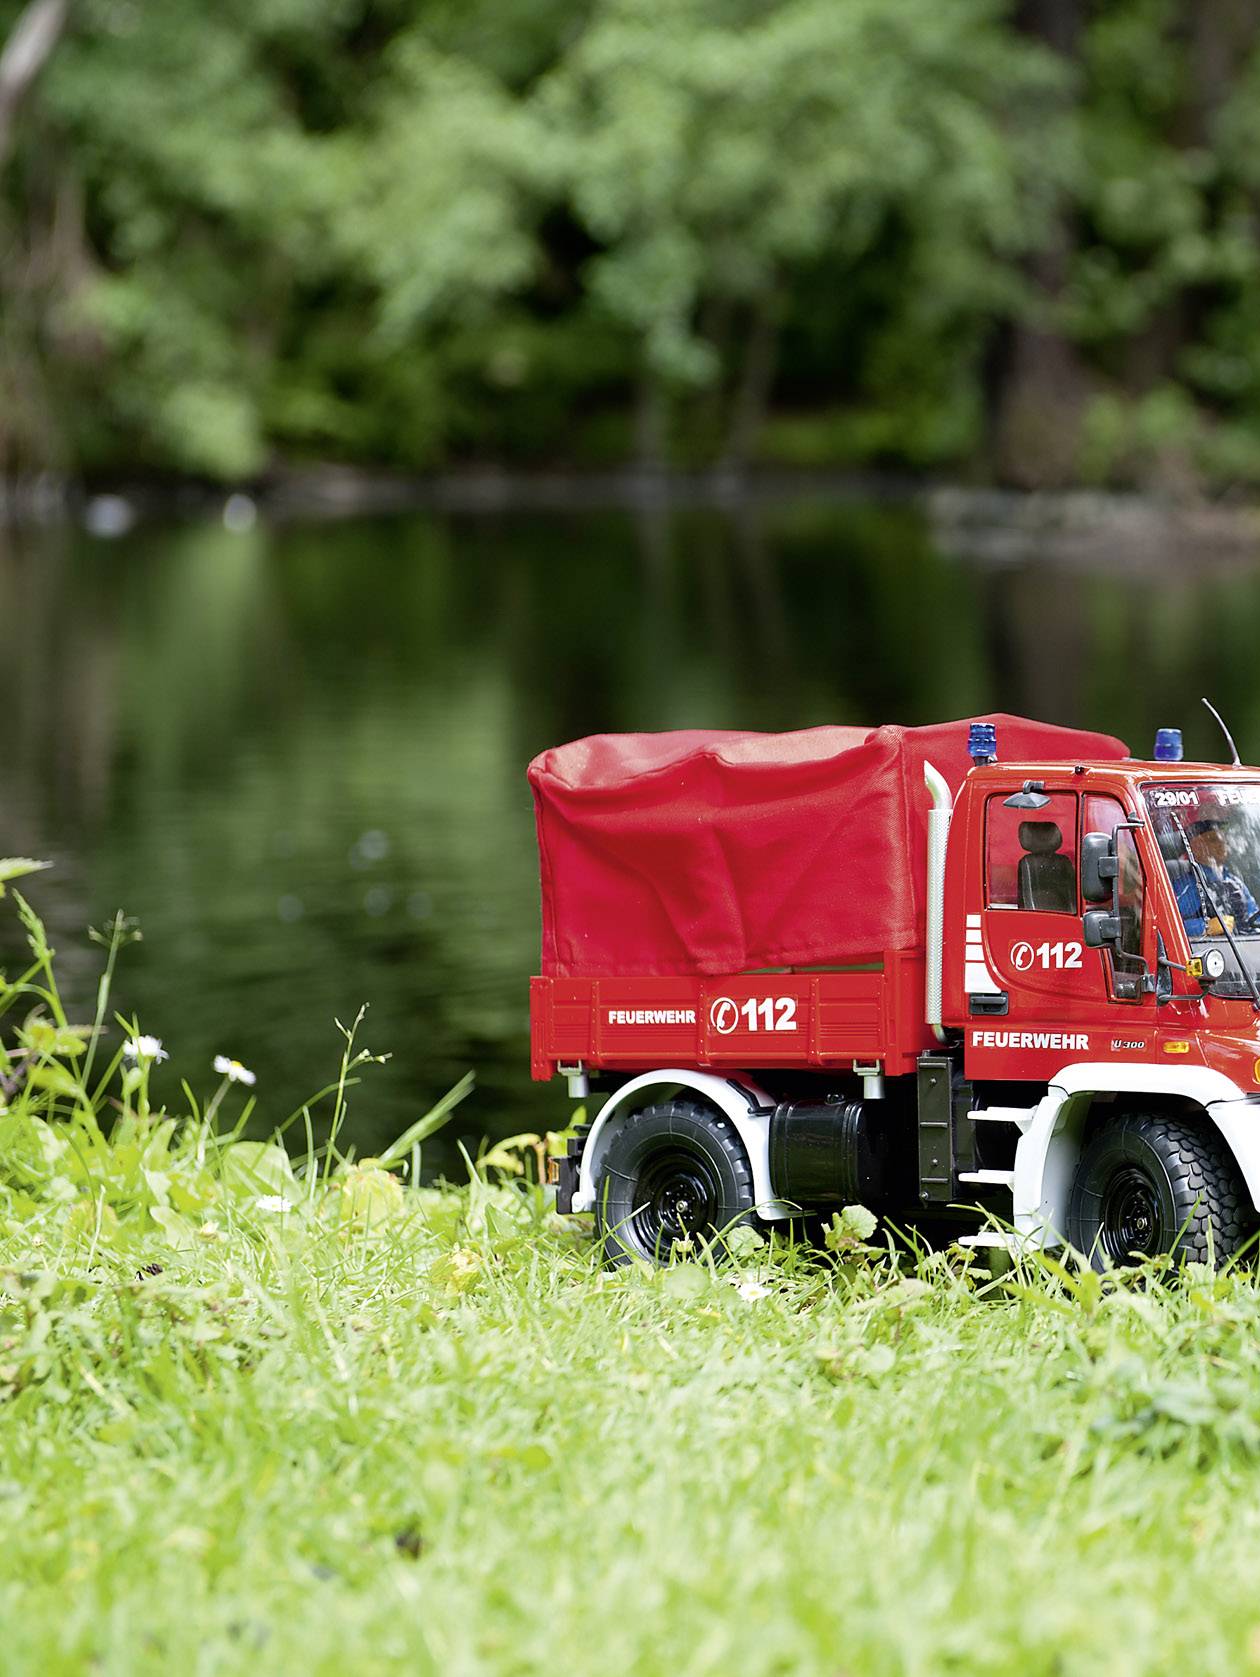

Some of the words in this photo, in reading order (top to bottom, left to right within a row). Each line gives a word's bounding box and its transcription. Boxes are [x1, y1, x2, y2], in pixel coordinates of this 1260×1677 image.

[1036, 941, 1083, 969] 112
[608, 1009, 696, 1025] FEUERWEHR
[741, 997, 797, 1031] 112
[972, 1030, 1089, 1050] FEUERWEHR
